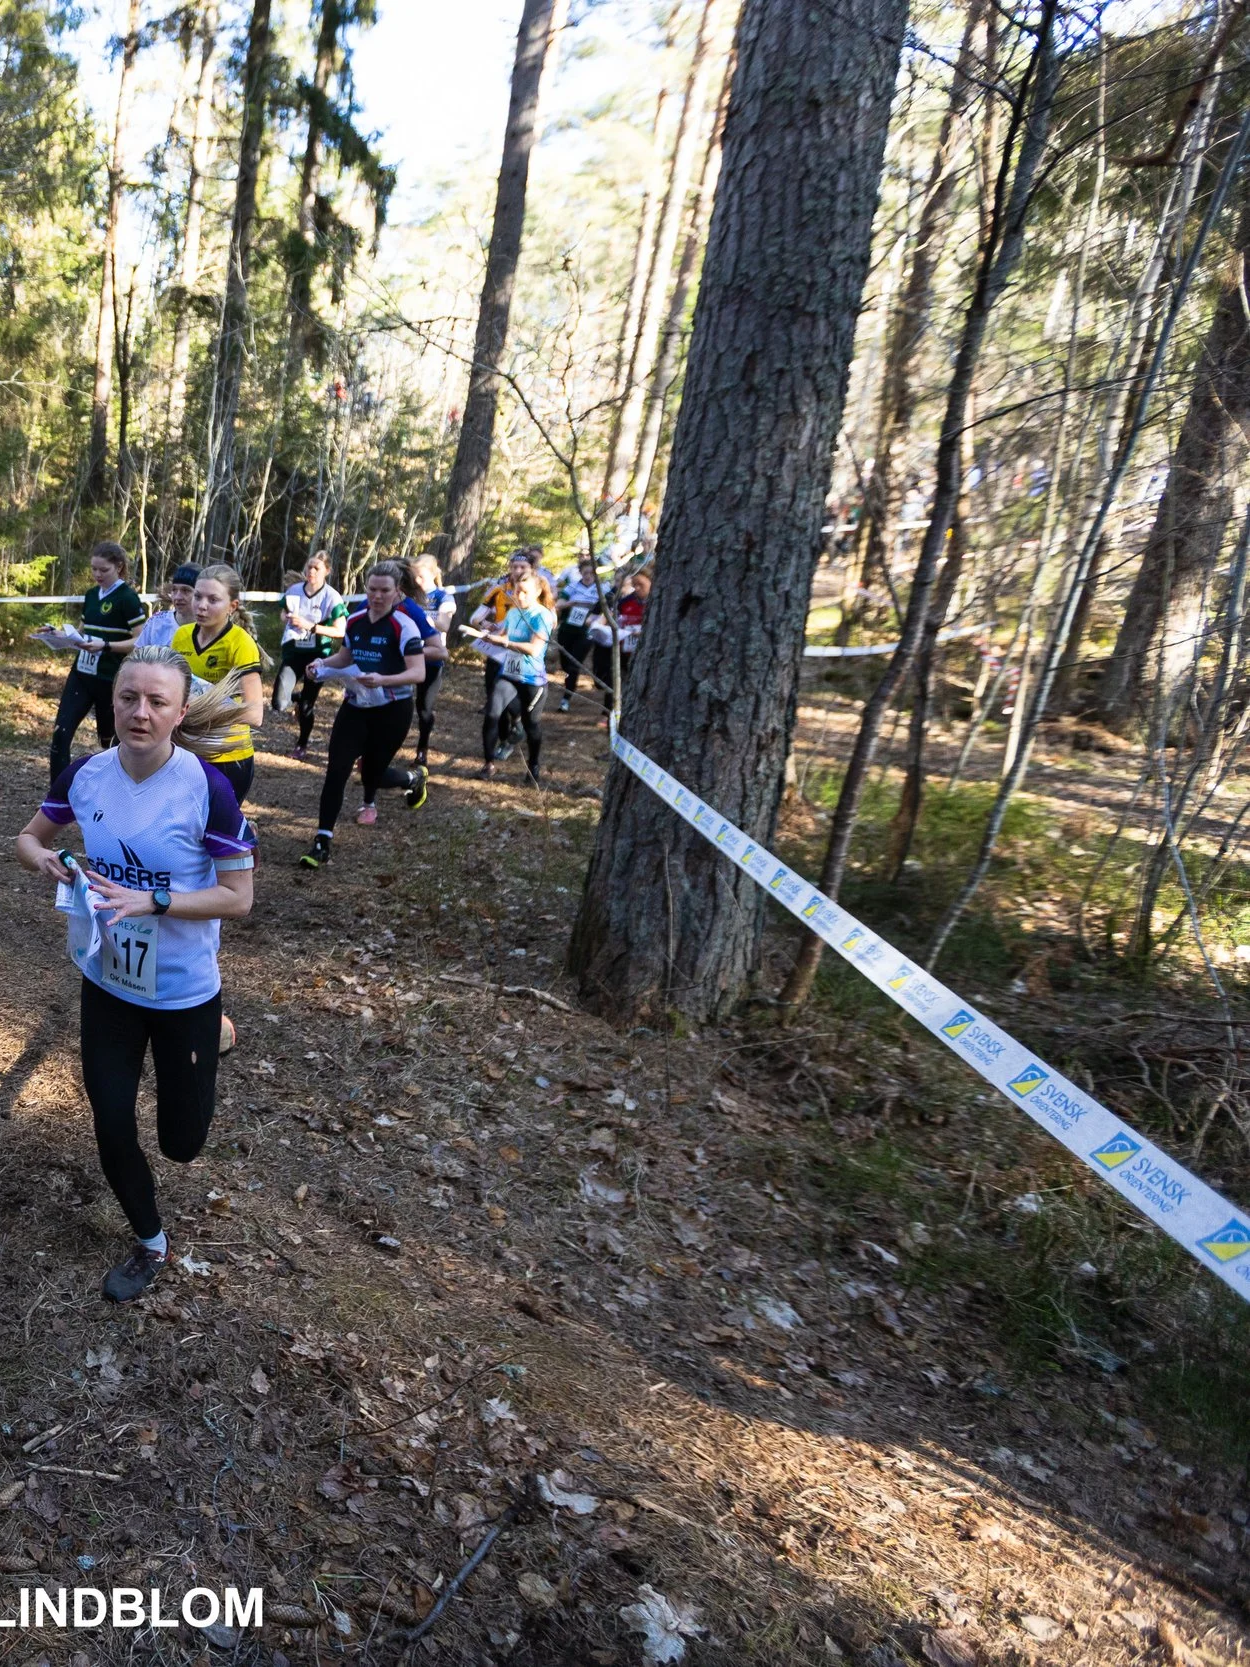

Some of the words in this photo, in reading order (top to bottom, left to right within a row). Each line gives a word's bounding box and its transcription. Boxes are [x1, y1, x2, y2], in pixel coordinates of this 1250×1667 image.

[113, 932, 149, 978] 117
[110, 973, 121, 984] OK
[121, 977, 147, 993] Måsen
[958, 1037, 995, 1066] ORIENTERING
[967, 1026, 1007, 1059] SVENSK
[1029, 1095, 1073, 1131] ORIENTERING
[1040, 1084, 1088, 1123] SVENSK
[1119, 1169, 1175, 1213] ORIENTERING
[1132, 1157, 1192, 1206] SVENSK
